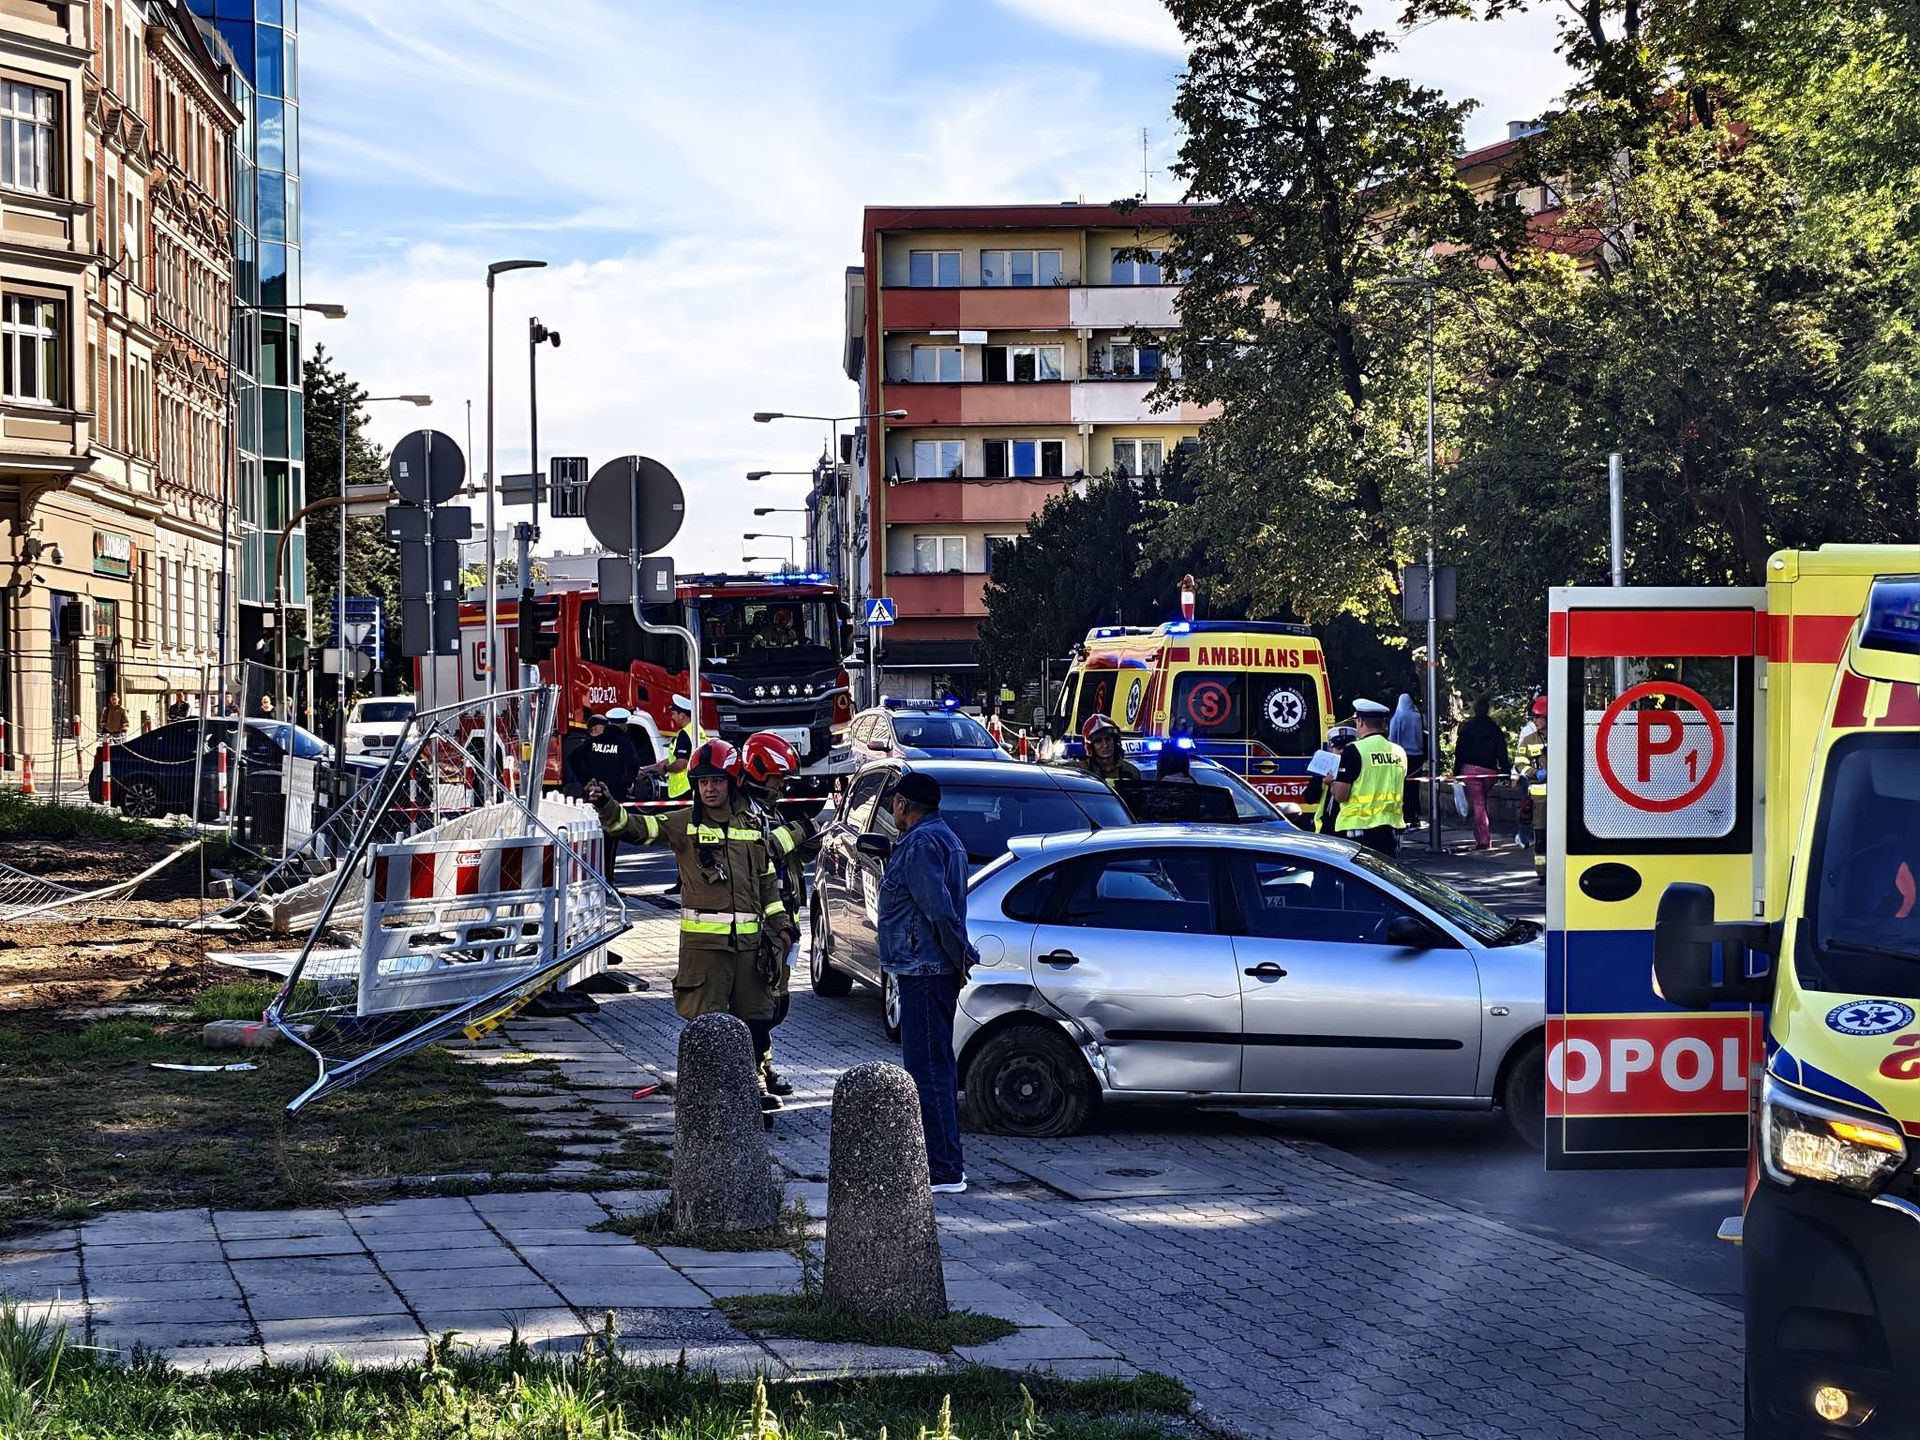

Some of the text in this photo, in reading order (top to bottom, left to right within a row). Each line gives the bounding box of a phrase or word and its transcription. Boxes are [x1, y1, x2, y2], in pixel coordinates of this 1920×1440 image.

[1198, 647, 1300, 668] AMBULANS
[1200, 691, 1219, 718] S
[592, 742, 618, 754] POLICJA
[1547, 1036, 1748, 1094] OPOL
